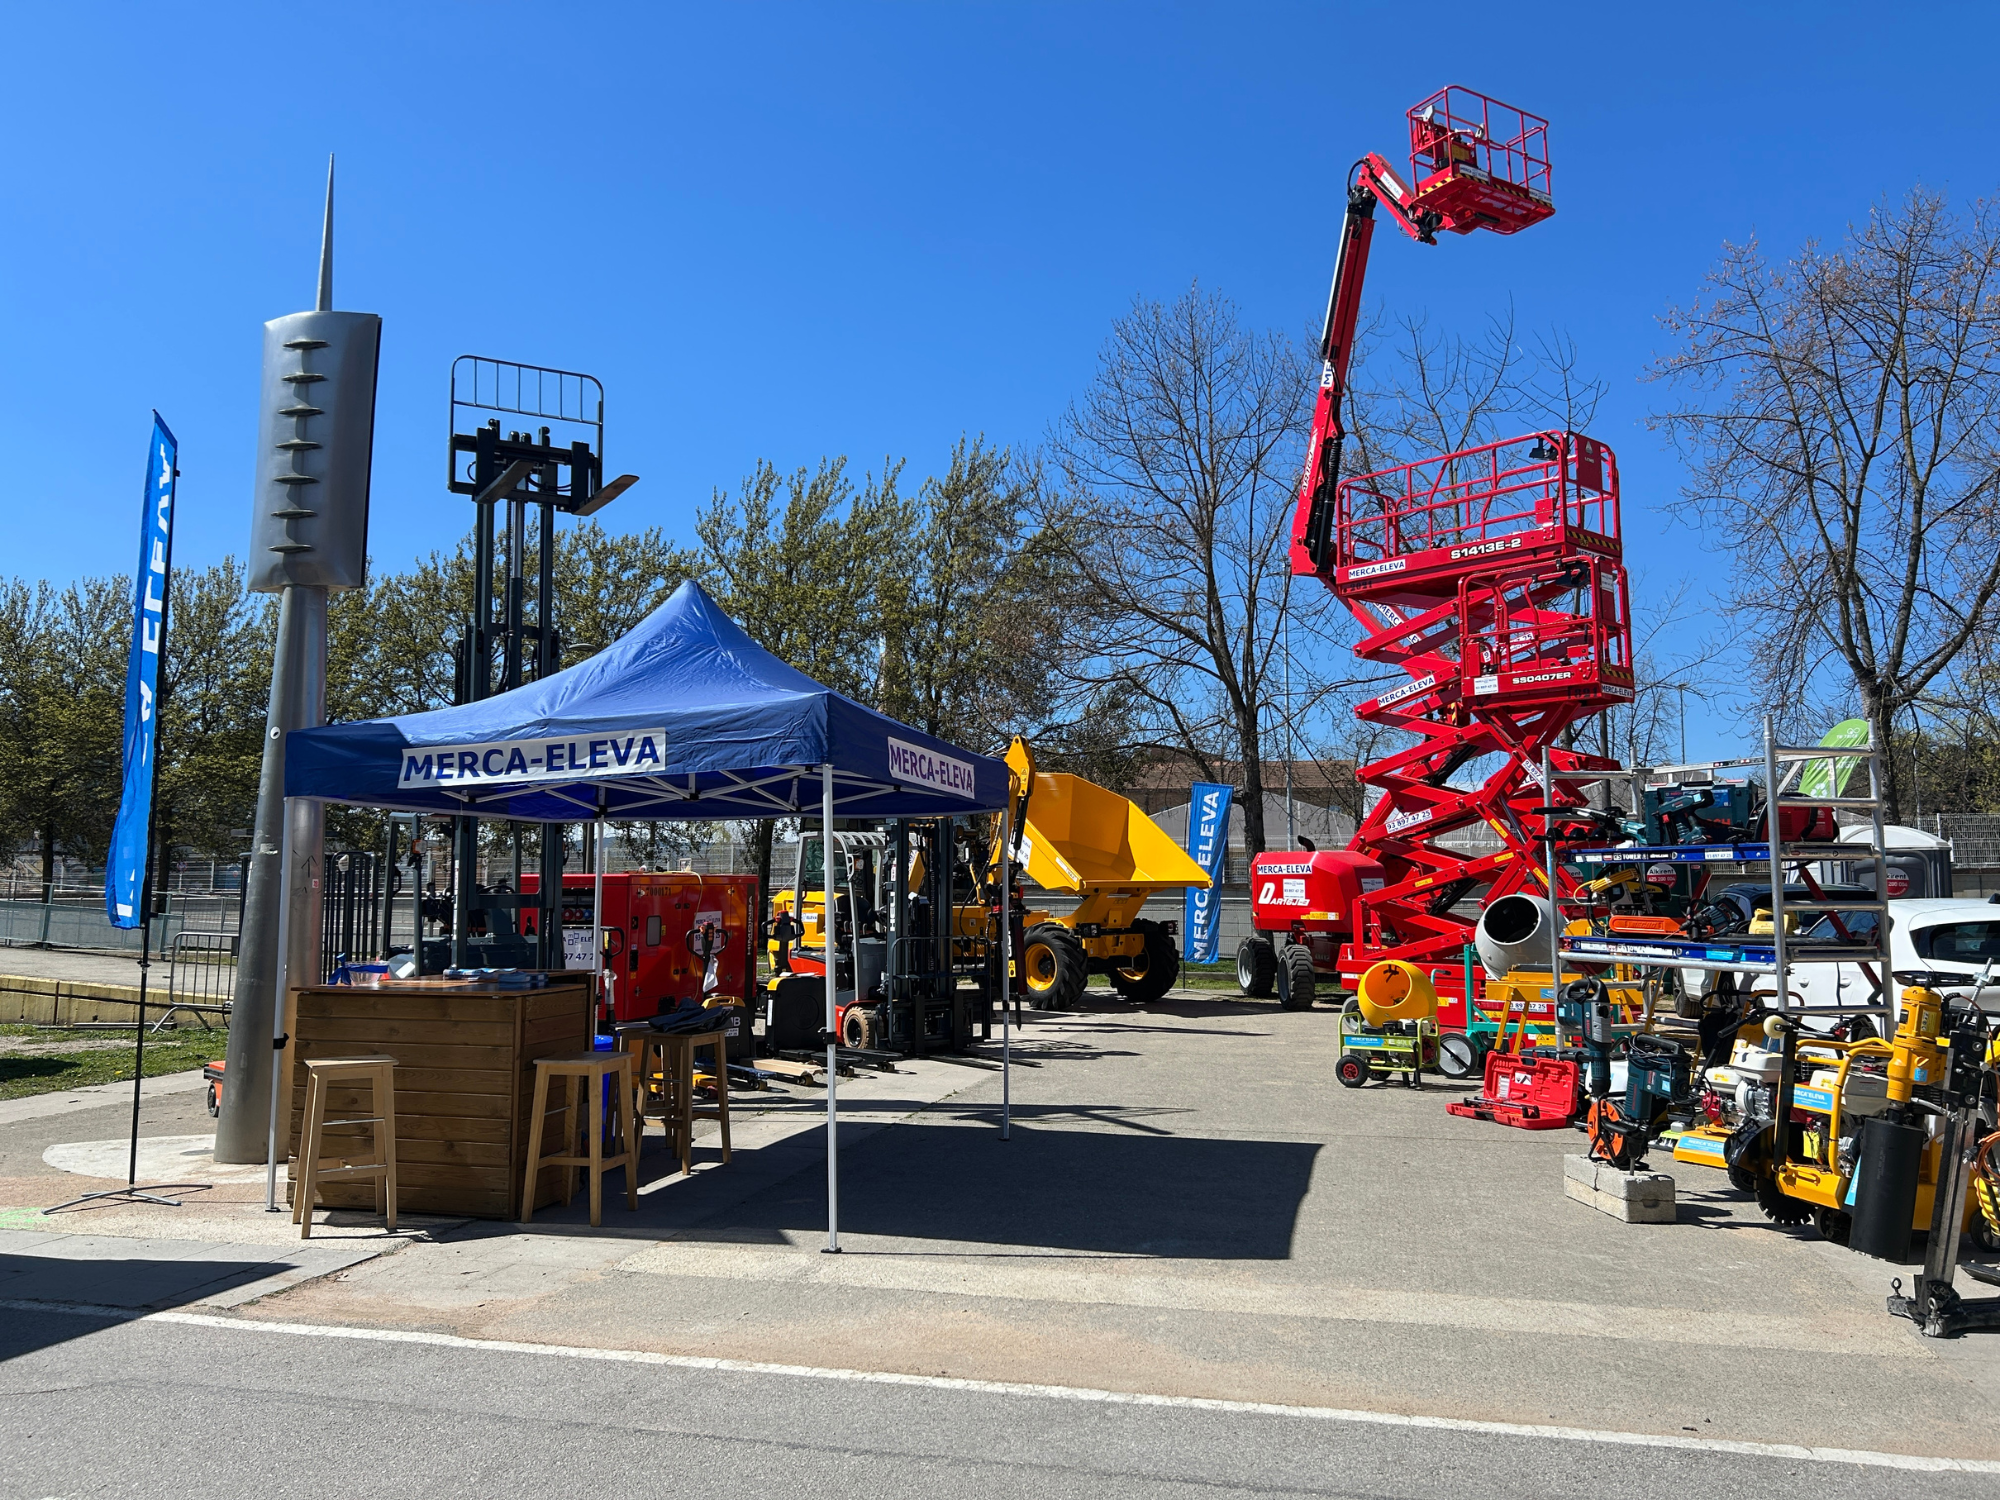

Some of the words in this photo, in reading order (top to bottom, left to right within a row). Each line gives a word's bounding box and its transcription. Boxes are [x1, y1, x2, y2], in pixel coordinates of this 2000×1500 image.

[1451, 538, 1521, 559] S1413E-2
[1349, 561, 1405, 578] MERCA-ELEVA
[1378, 675, 1434, 705] MERCA-ELEVA
[403, 736, 661, 782] MERCA-ELEVA
[889, 744, 973, 793] MERCA-ELEVA
[1197, 791, 1220, 866] ELEVA
[1257, 865, 1312, 874] MERCA-ELEVA
[1194, 887, 1209, 960] MERC
